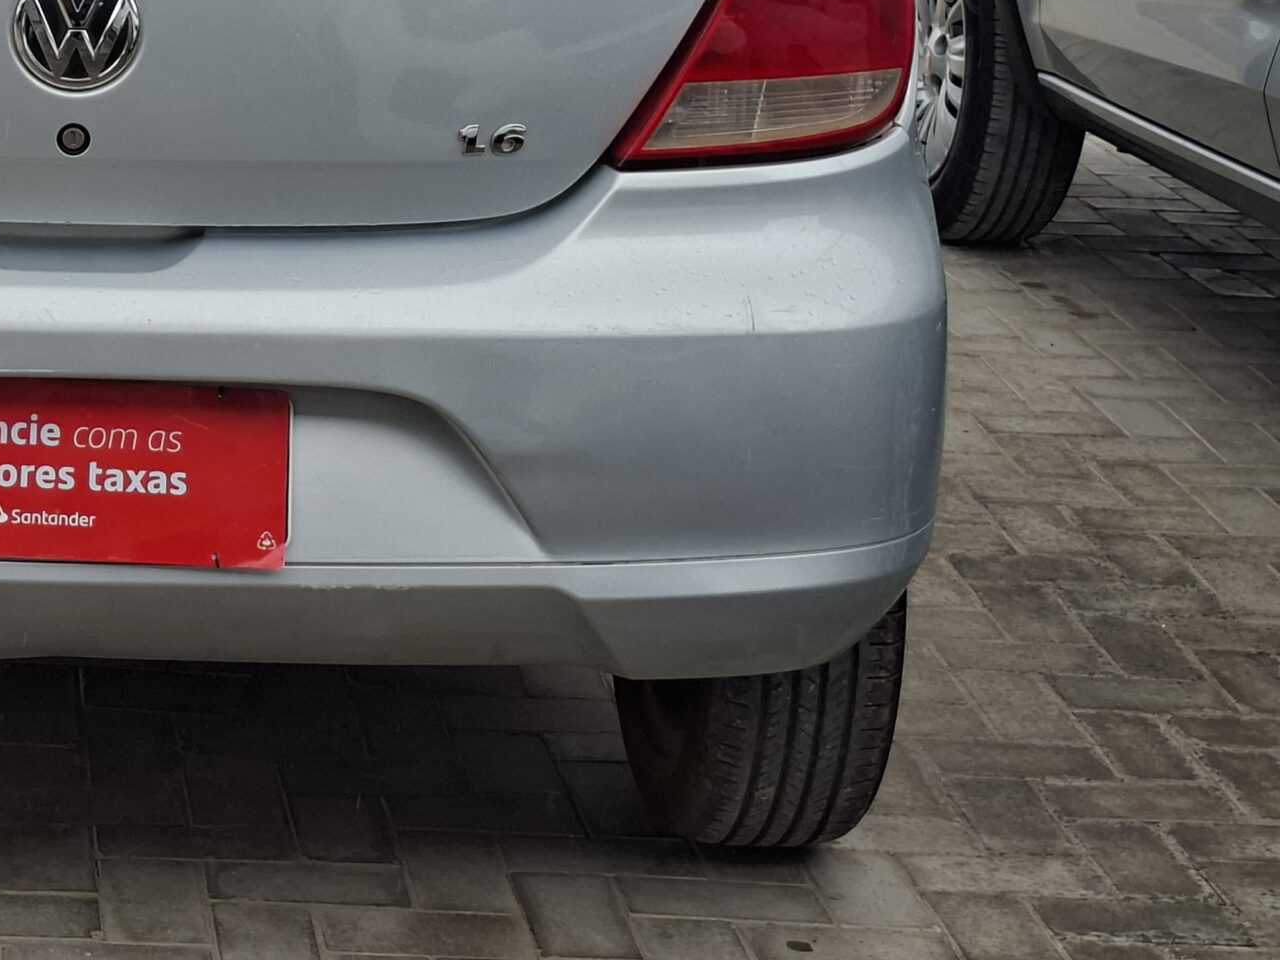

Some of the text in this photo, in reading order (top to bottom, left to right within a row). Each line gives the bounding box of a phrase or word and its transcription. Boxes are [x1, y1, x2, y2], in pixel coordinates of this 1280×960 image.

[73, 426, 138, 450] com
[147, 430, 183, 452] as
[88, 461, 187, 495] taxas
[11, 508, 96, 527] Santander
